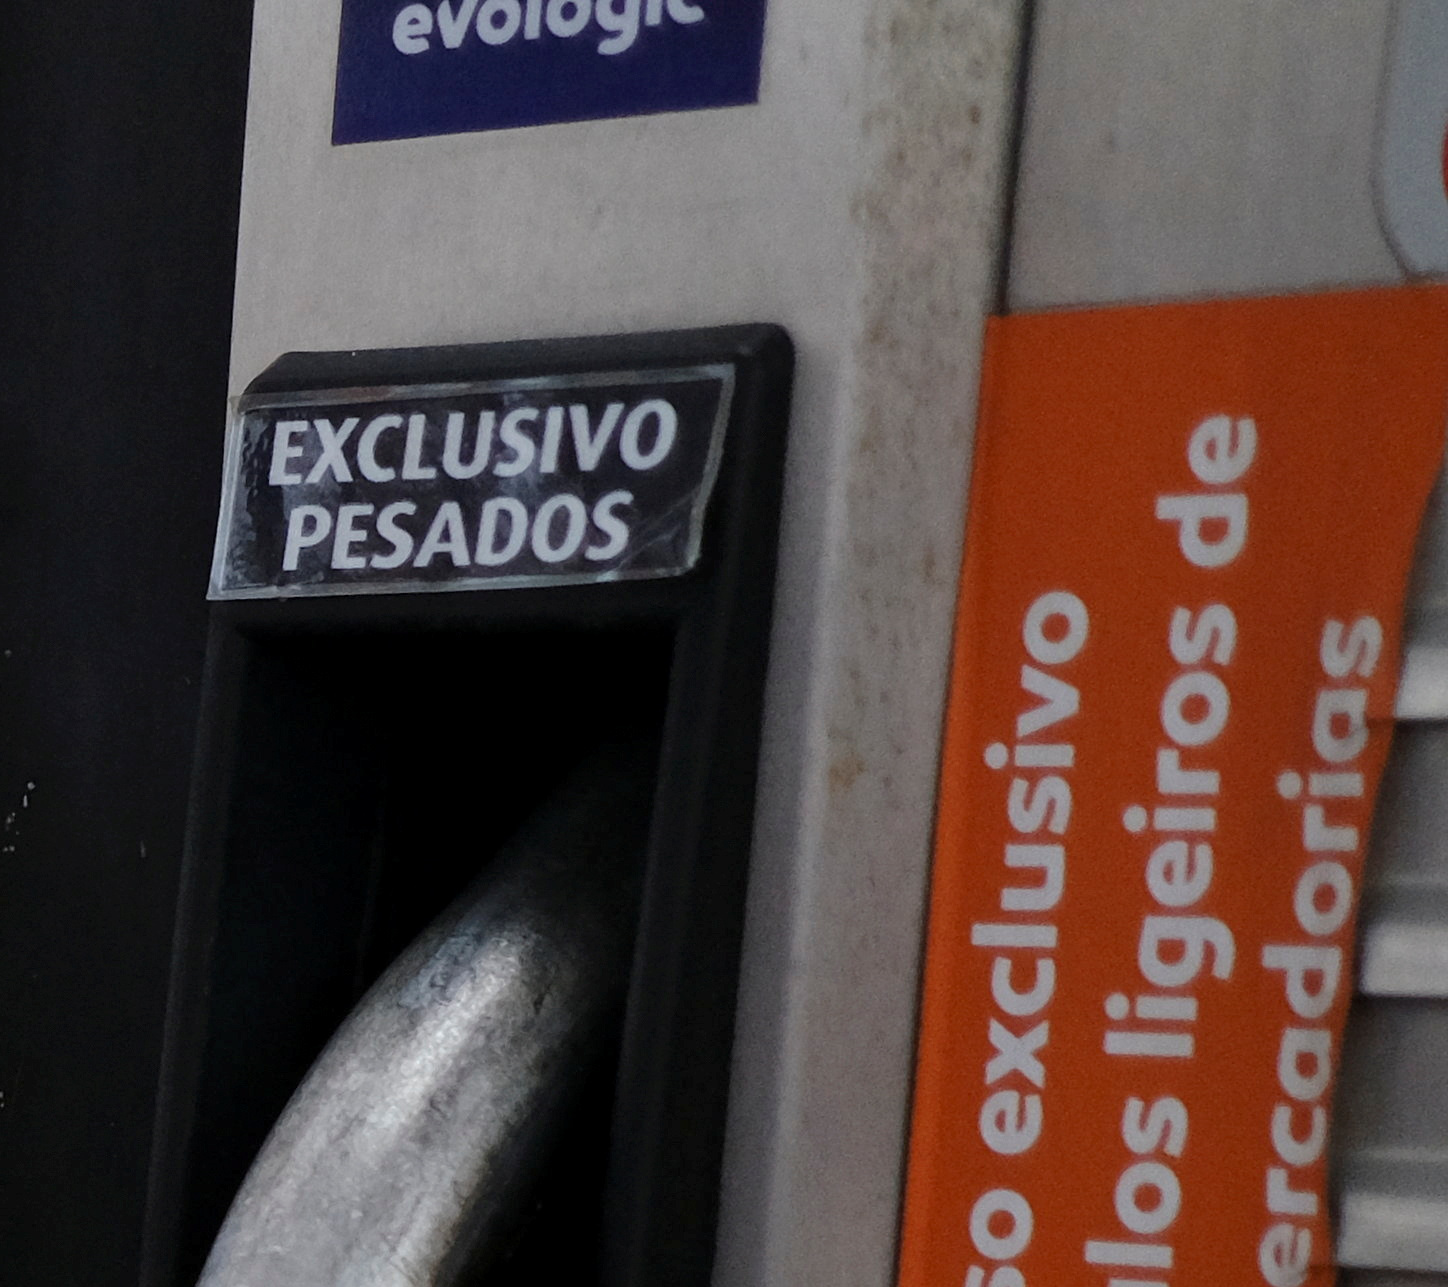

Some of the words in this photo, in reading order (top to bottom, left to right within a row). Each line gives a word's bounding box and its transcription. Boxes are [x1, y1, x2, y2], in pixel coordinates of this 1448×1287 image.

[268, 399, 679, 487] EXCLUSIVO
[1156, 413, 1258, 569] de
[282, 489, 635, 572] PESADOS
[969, 590, 1089, 1156] exclusivo
[1103, 602, 1238, 1058] ligeiros
